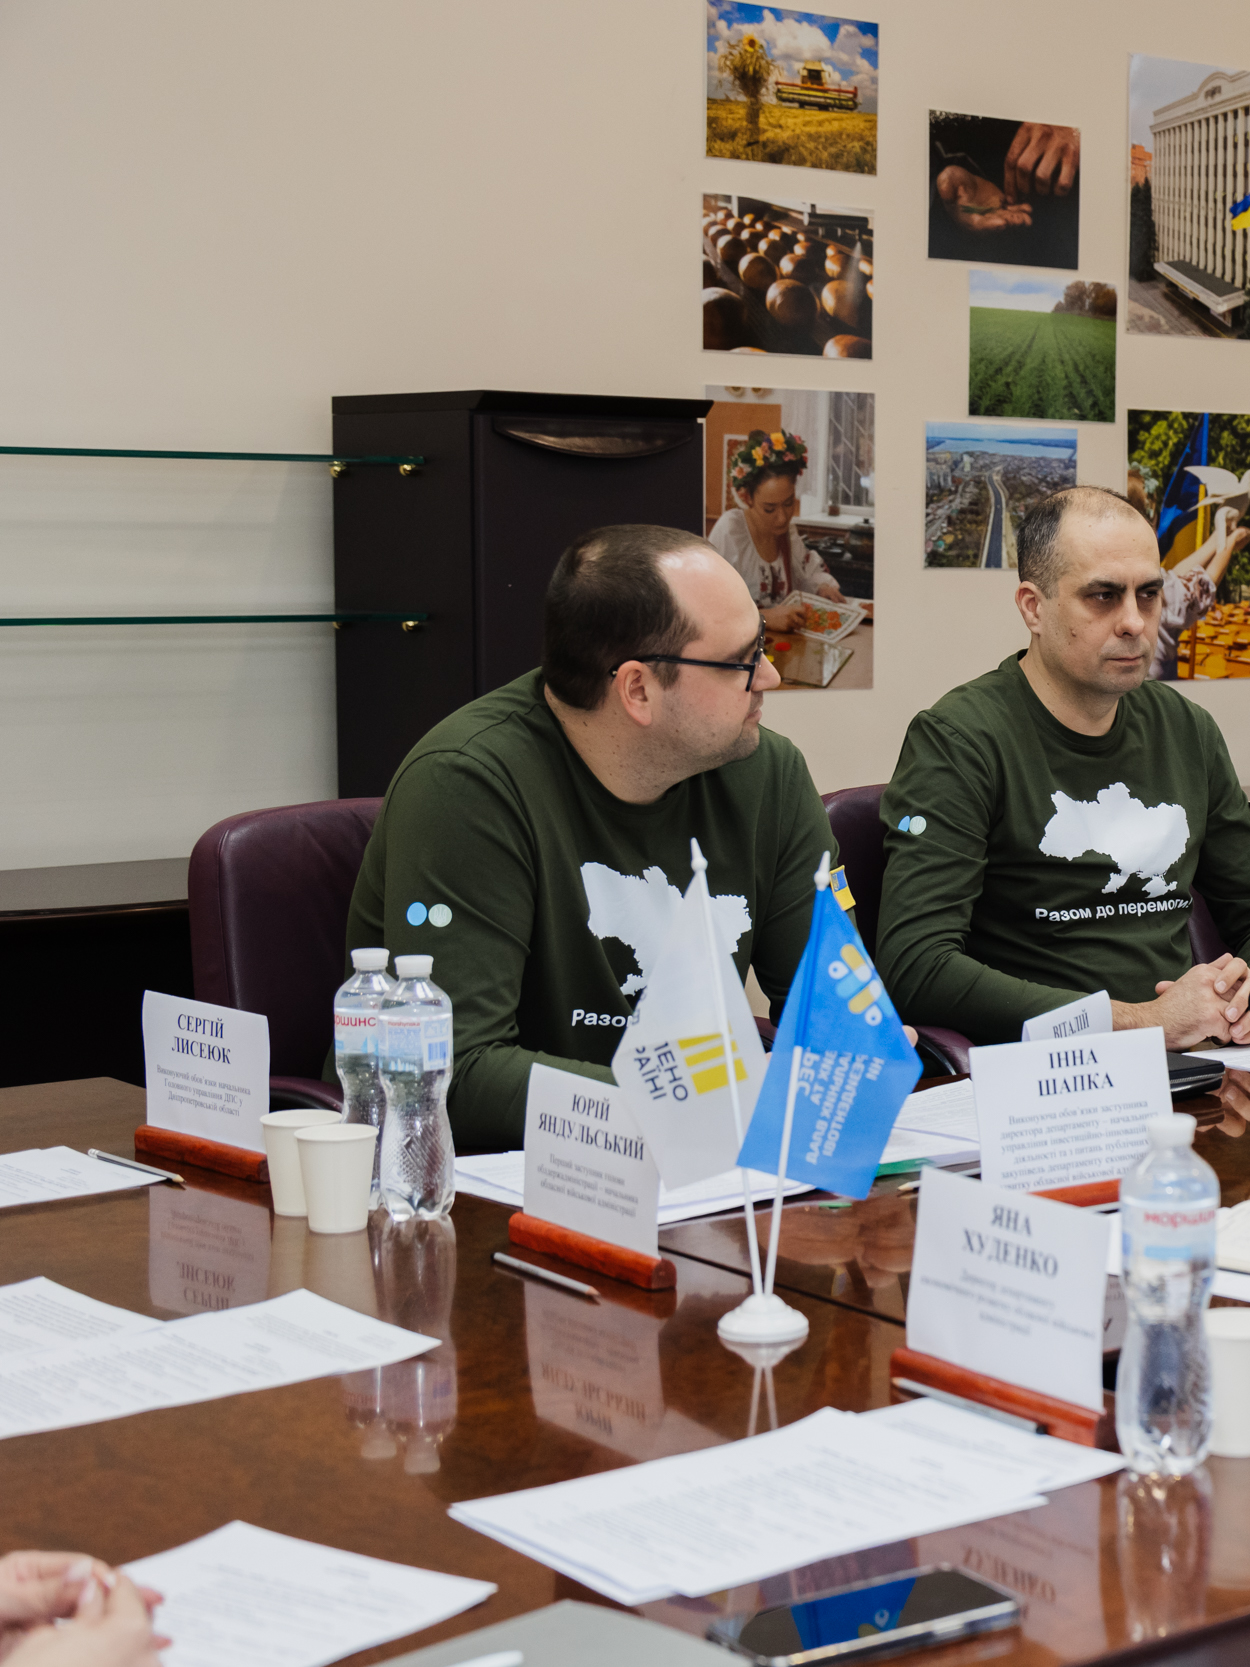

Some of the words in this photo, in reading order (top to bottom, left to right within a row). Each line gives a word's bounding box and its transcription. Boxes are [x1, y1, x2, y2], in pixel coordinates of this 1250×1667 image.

[1035, 906, 1092, 922] Разом
[1096, 905, 1115, 919] до
[1118, 897, 1193, 917] перемоги!
[177, 1013, 225, 1039] СЕРГІЙ
[1052, 1008, 1090, 1039] ВІТАЛІЙ
[171, 1036, 231, 1065] ЛИСЕЮК
[1048, 1048, 1099, 1069] ІННА
[1038, 1071, 1115, 1097] ШАПКА
[571, 1093, 611, 1122] ЮРІЙ
[538, 1112, 645, 1161] ЯНДУЛЬСЬКИЙ
[990, 1204, 1033, 1238] ЯНА
[963, 1228, 1059, 1279] ХУДЕНКО
